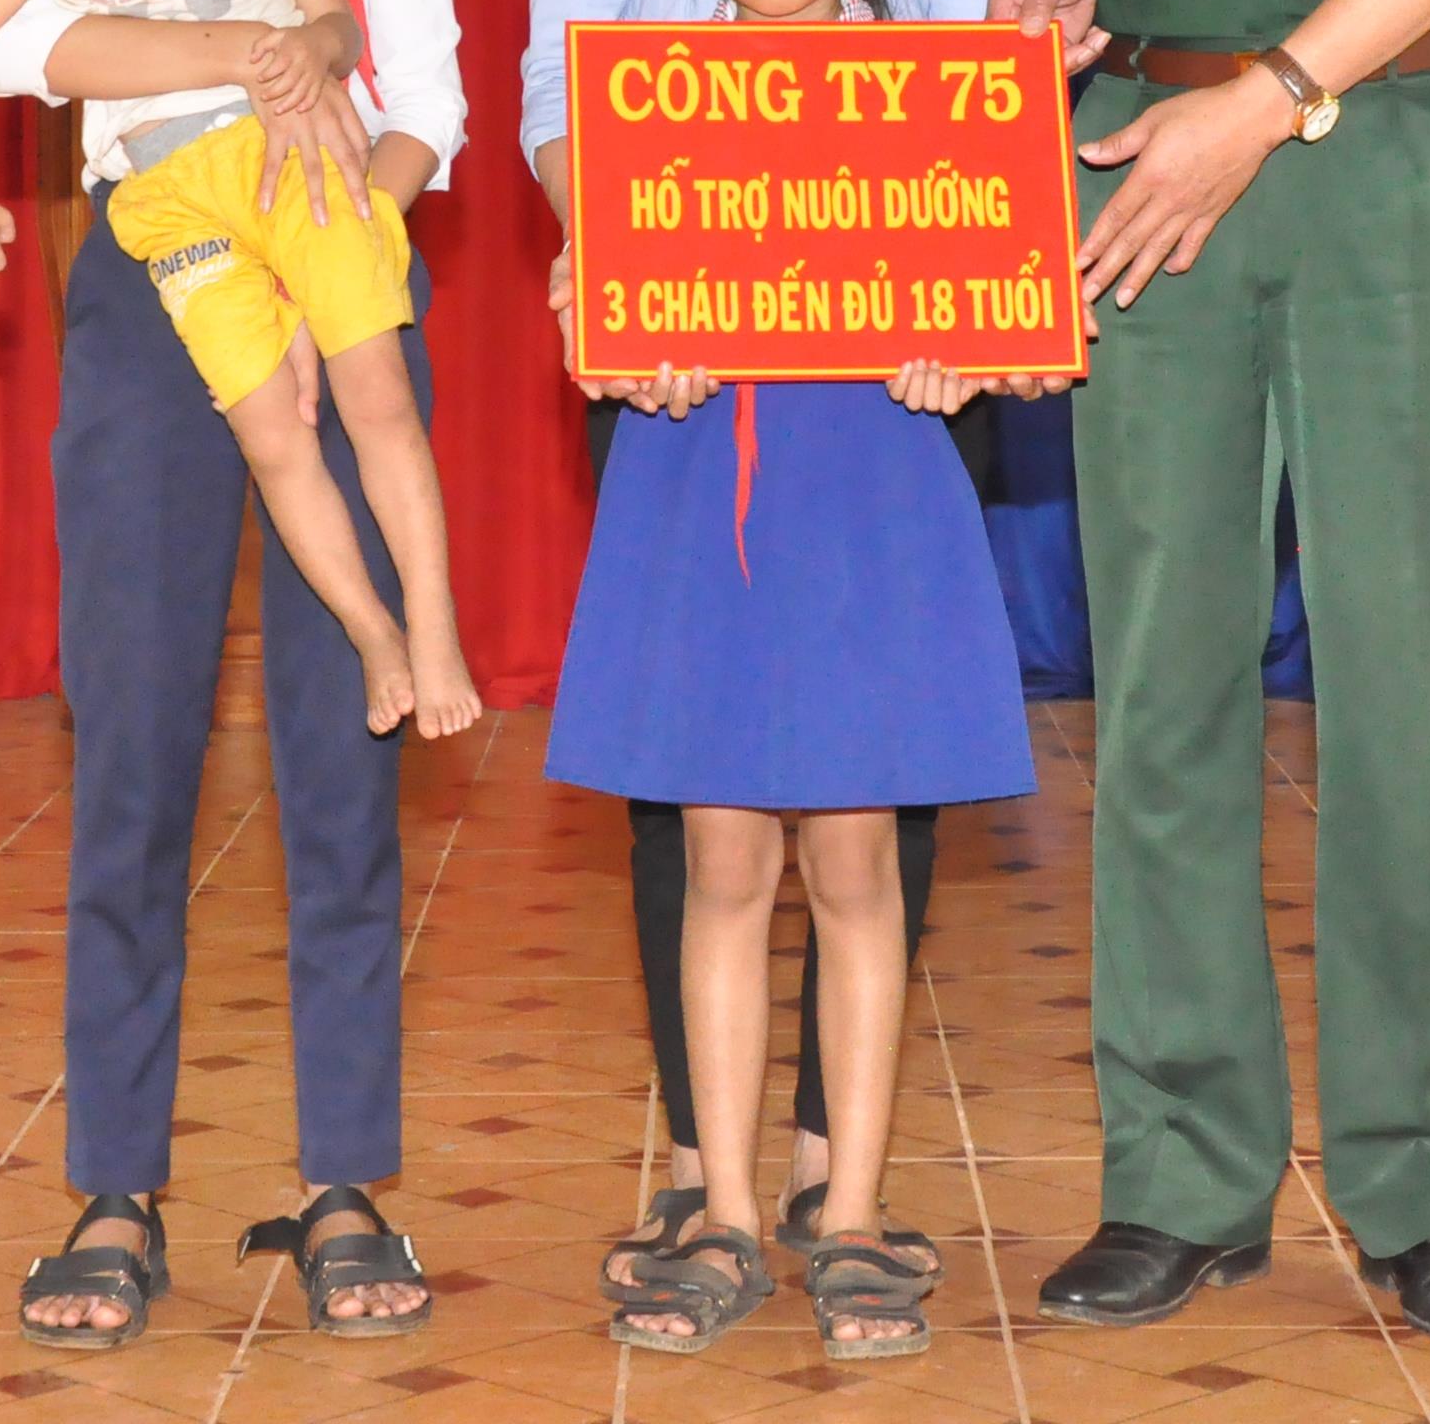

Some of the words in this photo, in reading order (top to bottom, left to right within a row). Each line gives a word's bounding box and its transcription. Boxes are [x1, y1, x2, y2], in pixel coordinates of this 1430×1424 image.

[608, 41, 804, 123] CÔNG
[825, 61, 917, 122] TY
[940, 57, 1023, 122] 75
[630, 158, 691, 230] HỖ
[693, 171, 770, 243] TRỢ
[782, 165, 872, 230] NUÔI
[882, 159, 1011, 229] DƯỠNG
[602, 279, 628, 333] 3
[638, 267, 740, 333] CHÁU
[751, 259, 831, 332] ĐẾN
[841, 259, 896, 332] ĐỦ
[910, 278, 957, 331] 18
[964, 249, 1055, 331] TUỔI
